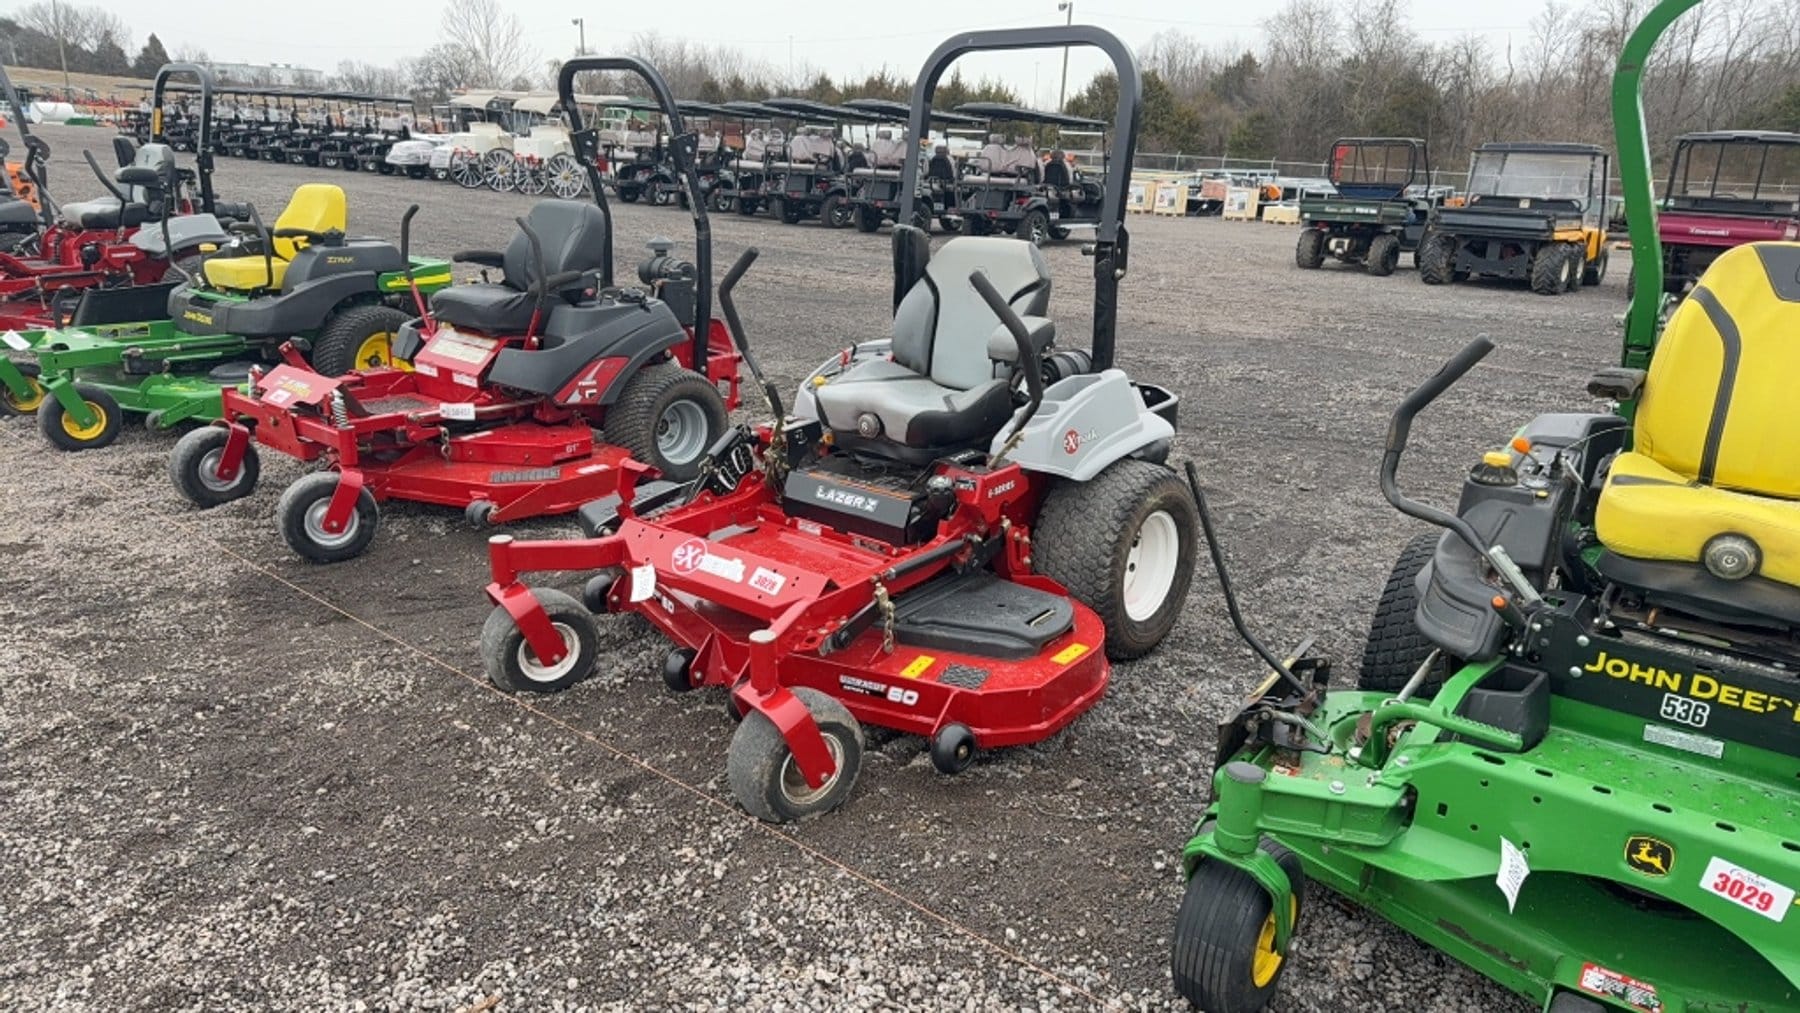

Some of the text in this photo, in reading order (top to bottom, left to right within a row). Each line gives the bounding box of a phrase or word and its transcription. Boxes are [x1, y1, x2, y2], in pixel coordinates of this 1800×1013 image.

[815, 485, 866, 507] LAZER
[1583, 651, 1652, 692] JOHN
[887, 686, 919, 706] 60
[1659, 692, 1710, 728] 536
[1713, 872, 1774, 912] 3029
